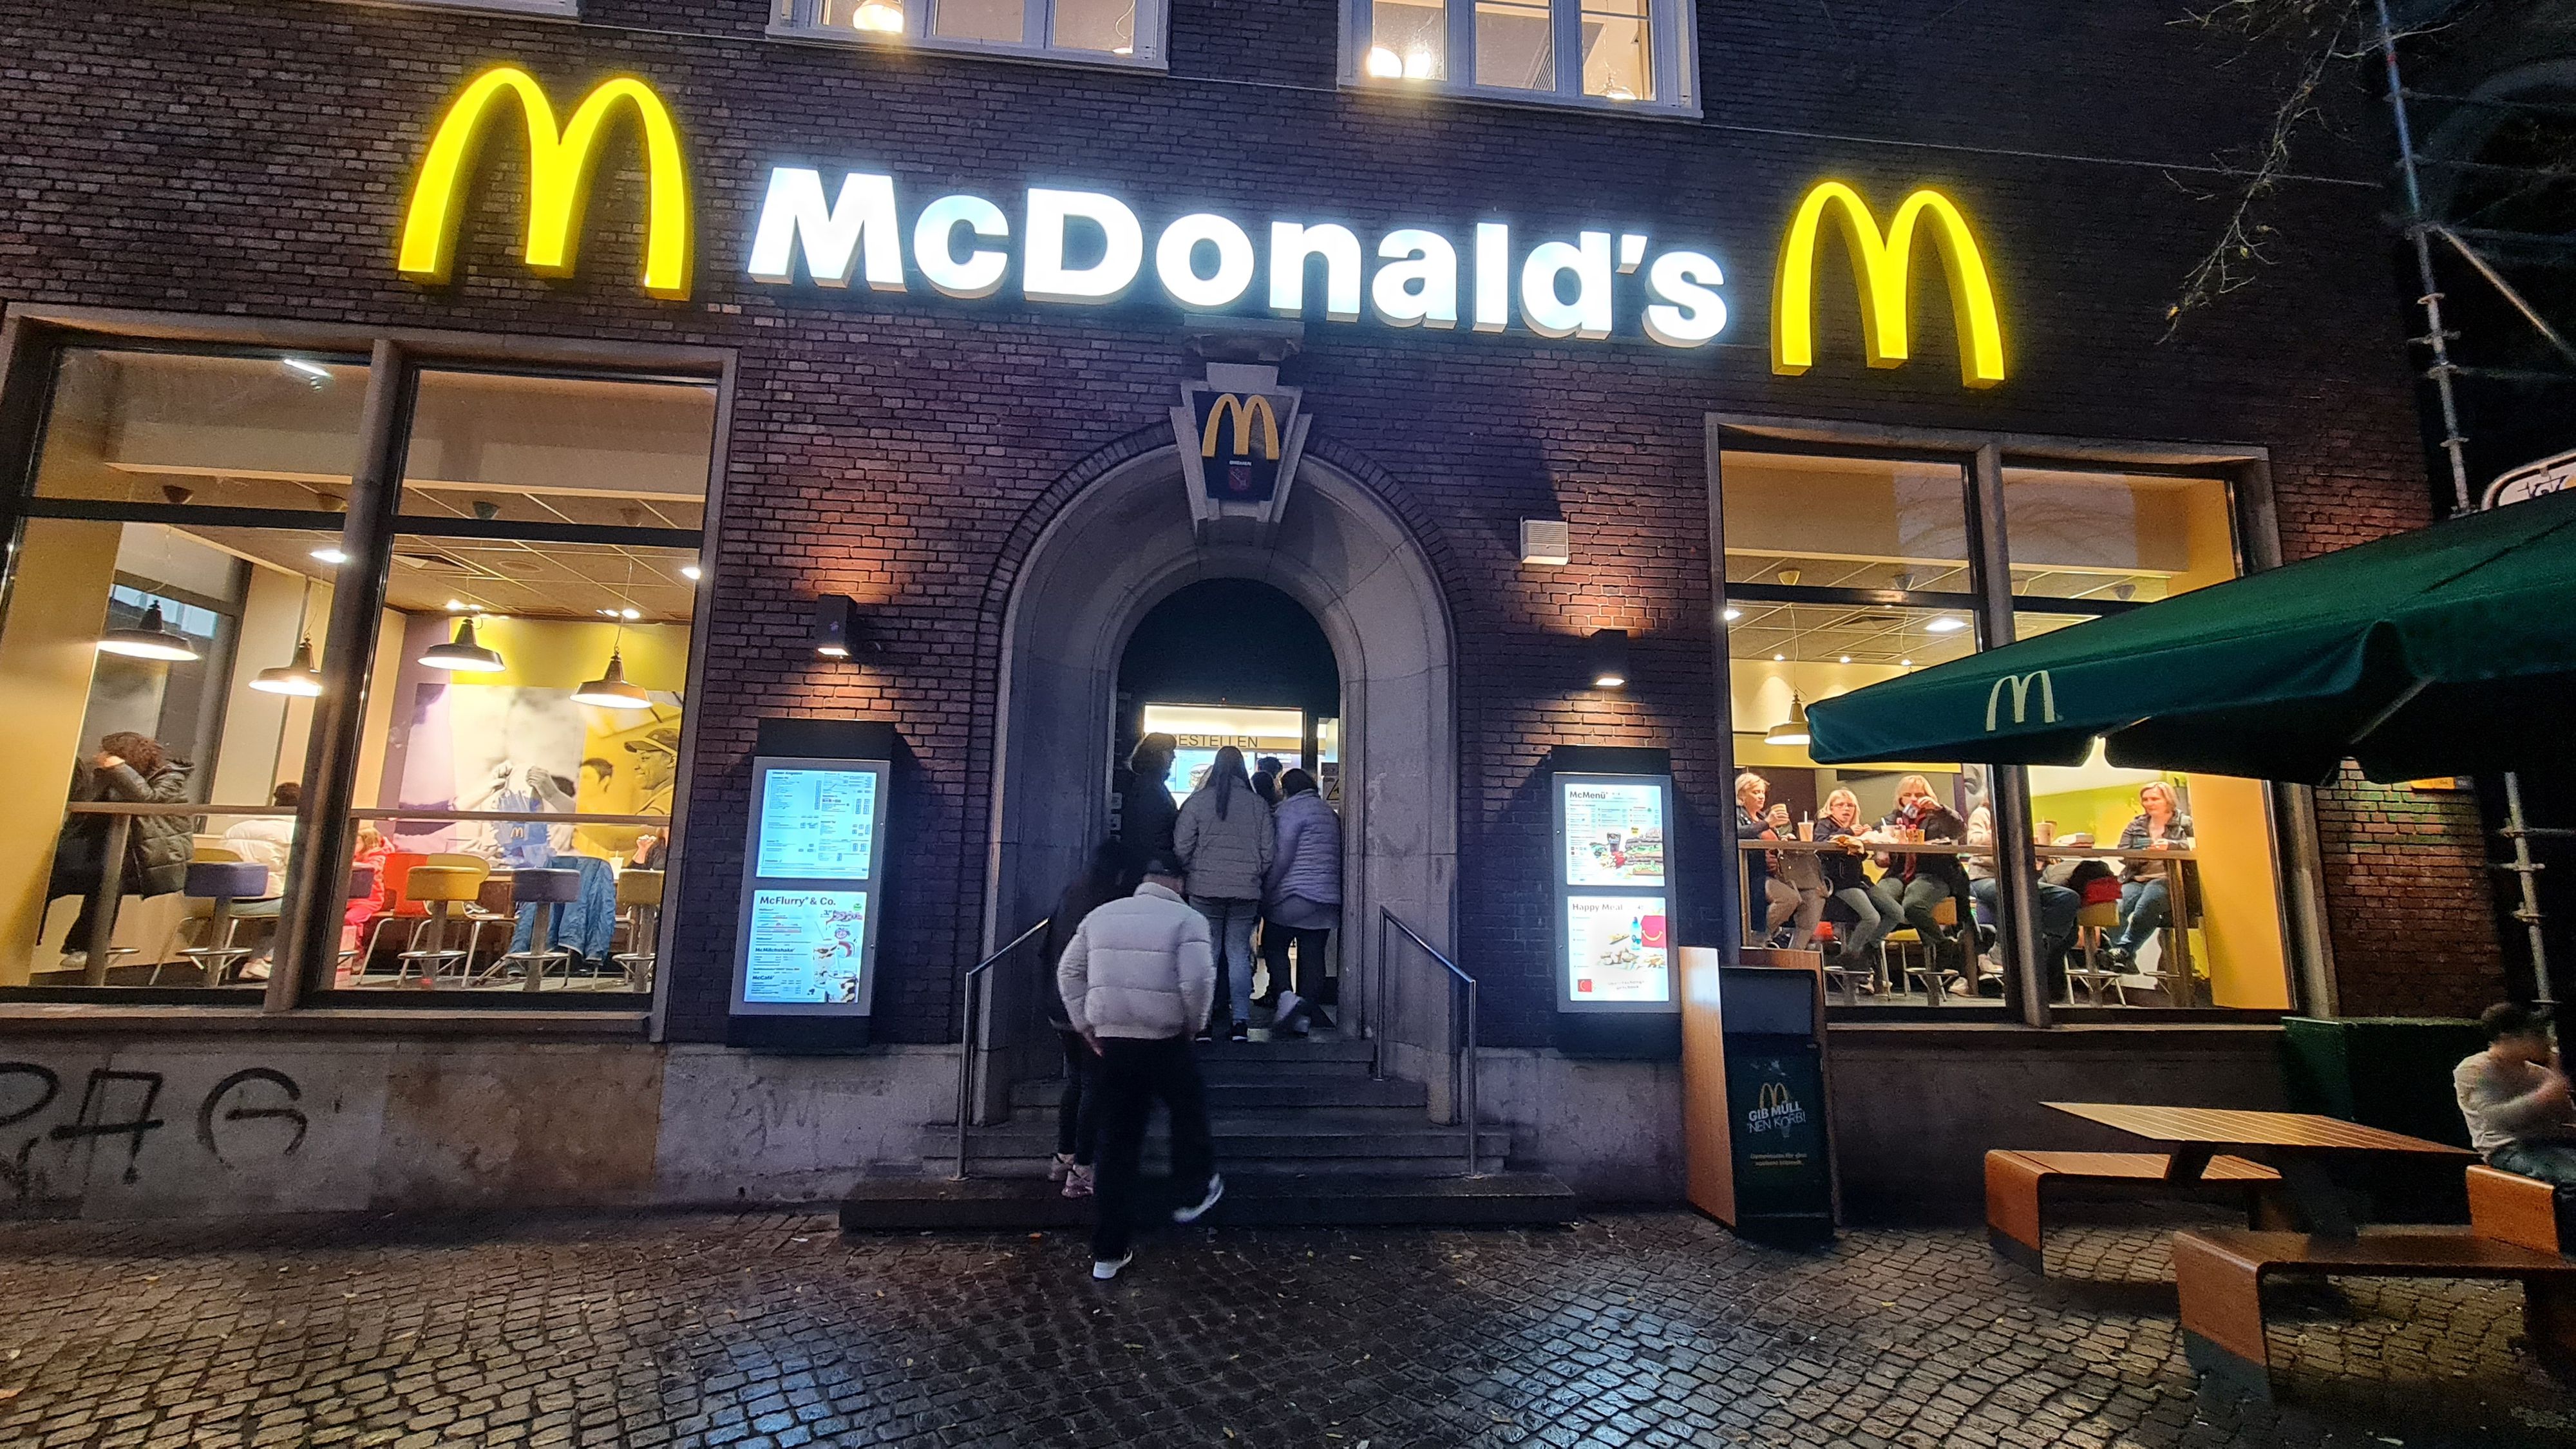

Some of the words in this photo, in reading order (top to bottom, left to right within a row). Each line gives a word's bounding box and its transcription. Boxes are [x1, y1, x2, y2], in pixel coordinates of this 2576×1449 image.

[747, 167, 1728, 348] McDonald's
[1174, 734, 1258, 748] ESTELLEN
[810, 897, 817, 905] &
[820, 897, 836, 905] Co.
[1572, 903, 1599, 912] Happy
[1748, 1108, 1770, 1122] GIB
[1771, 1100, 1803, 1117] MÜLL
